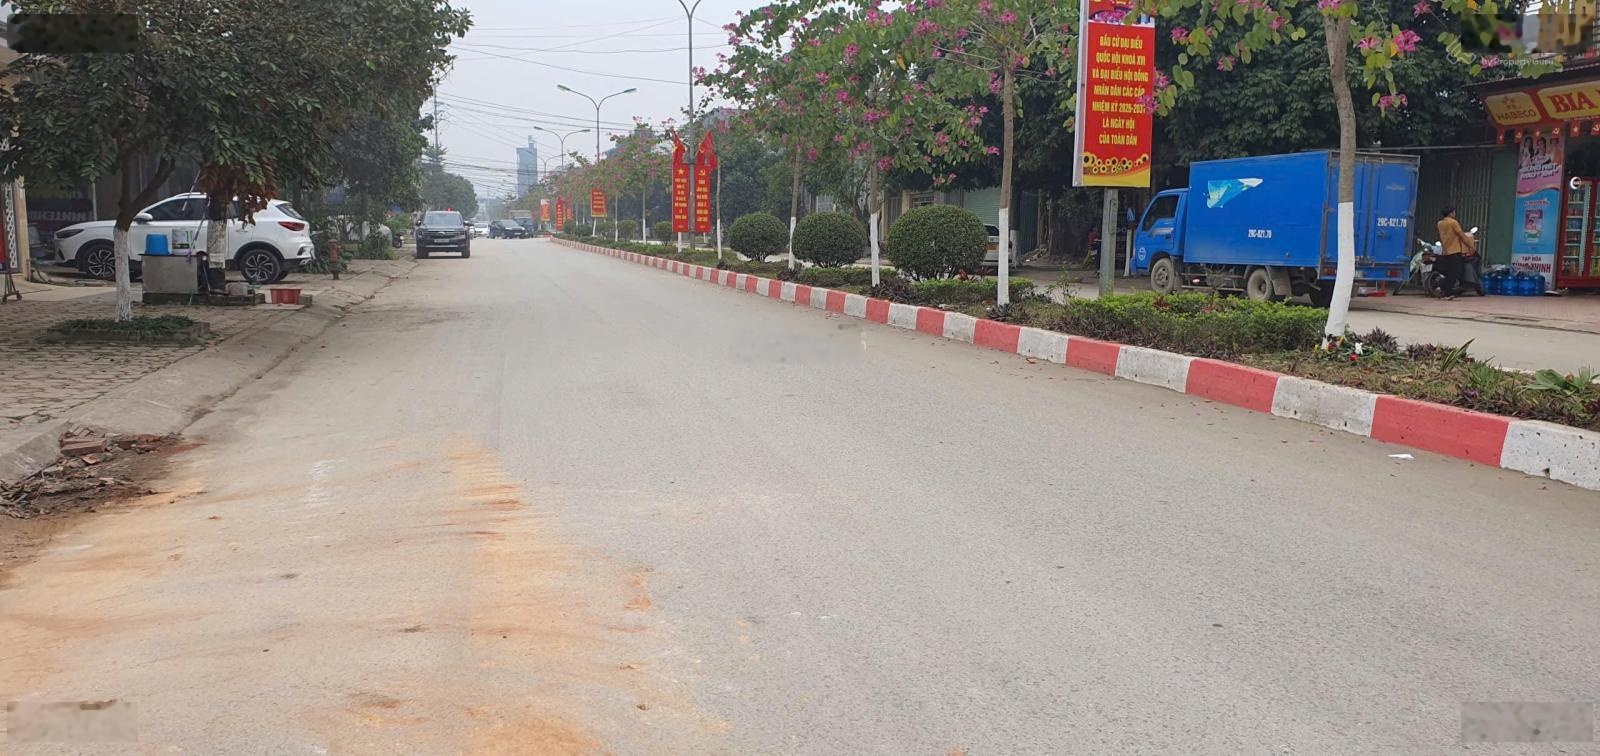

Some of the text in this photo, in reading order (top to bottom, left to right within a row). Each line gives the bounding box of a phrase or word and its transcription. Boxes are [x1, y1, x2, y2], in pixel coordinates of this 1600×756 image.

[1096, 50, 1110, 63] QUỐC
[1094, 83, 1109, 96] NHÂN
[1548, 92, 1597, 112] BIA
[1495, 109, 1537, 121] HABECO
